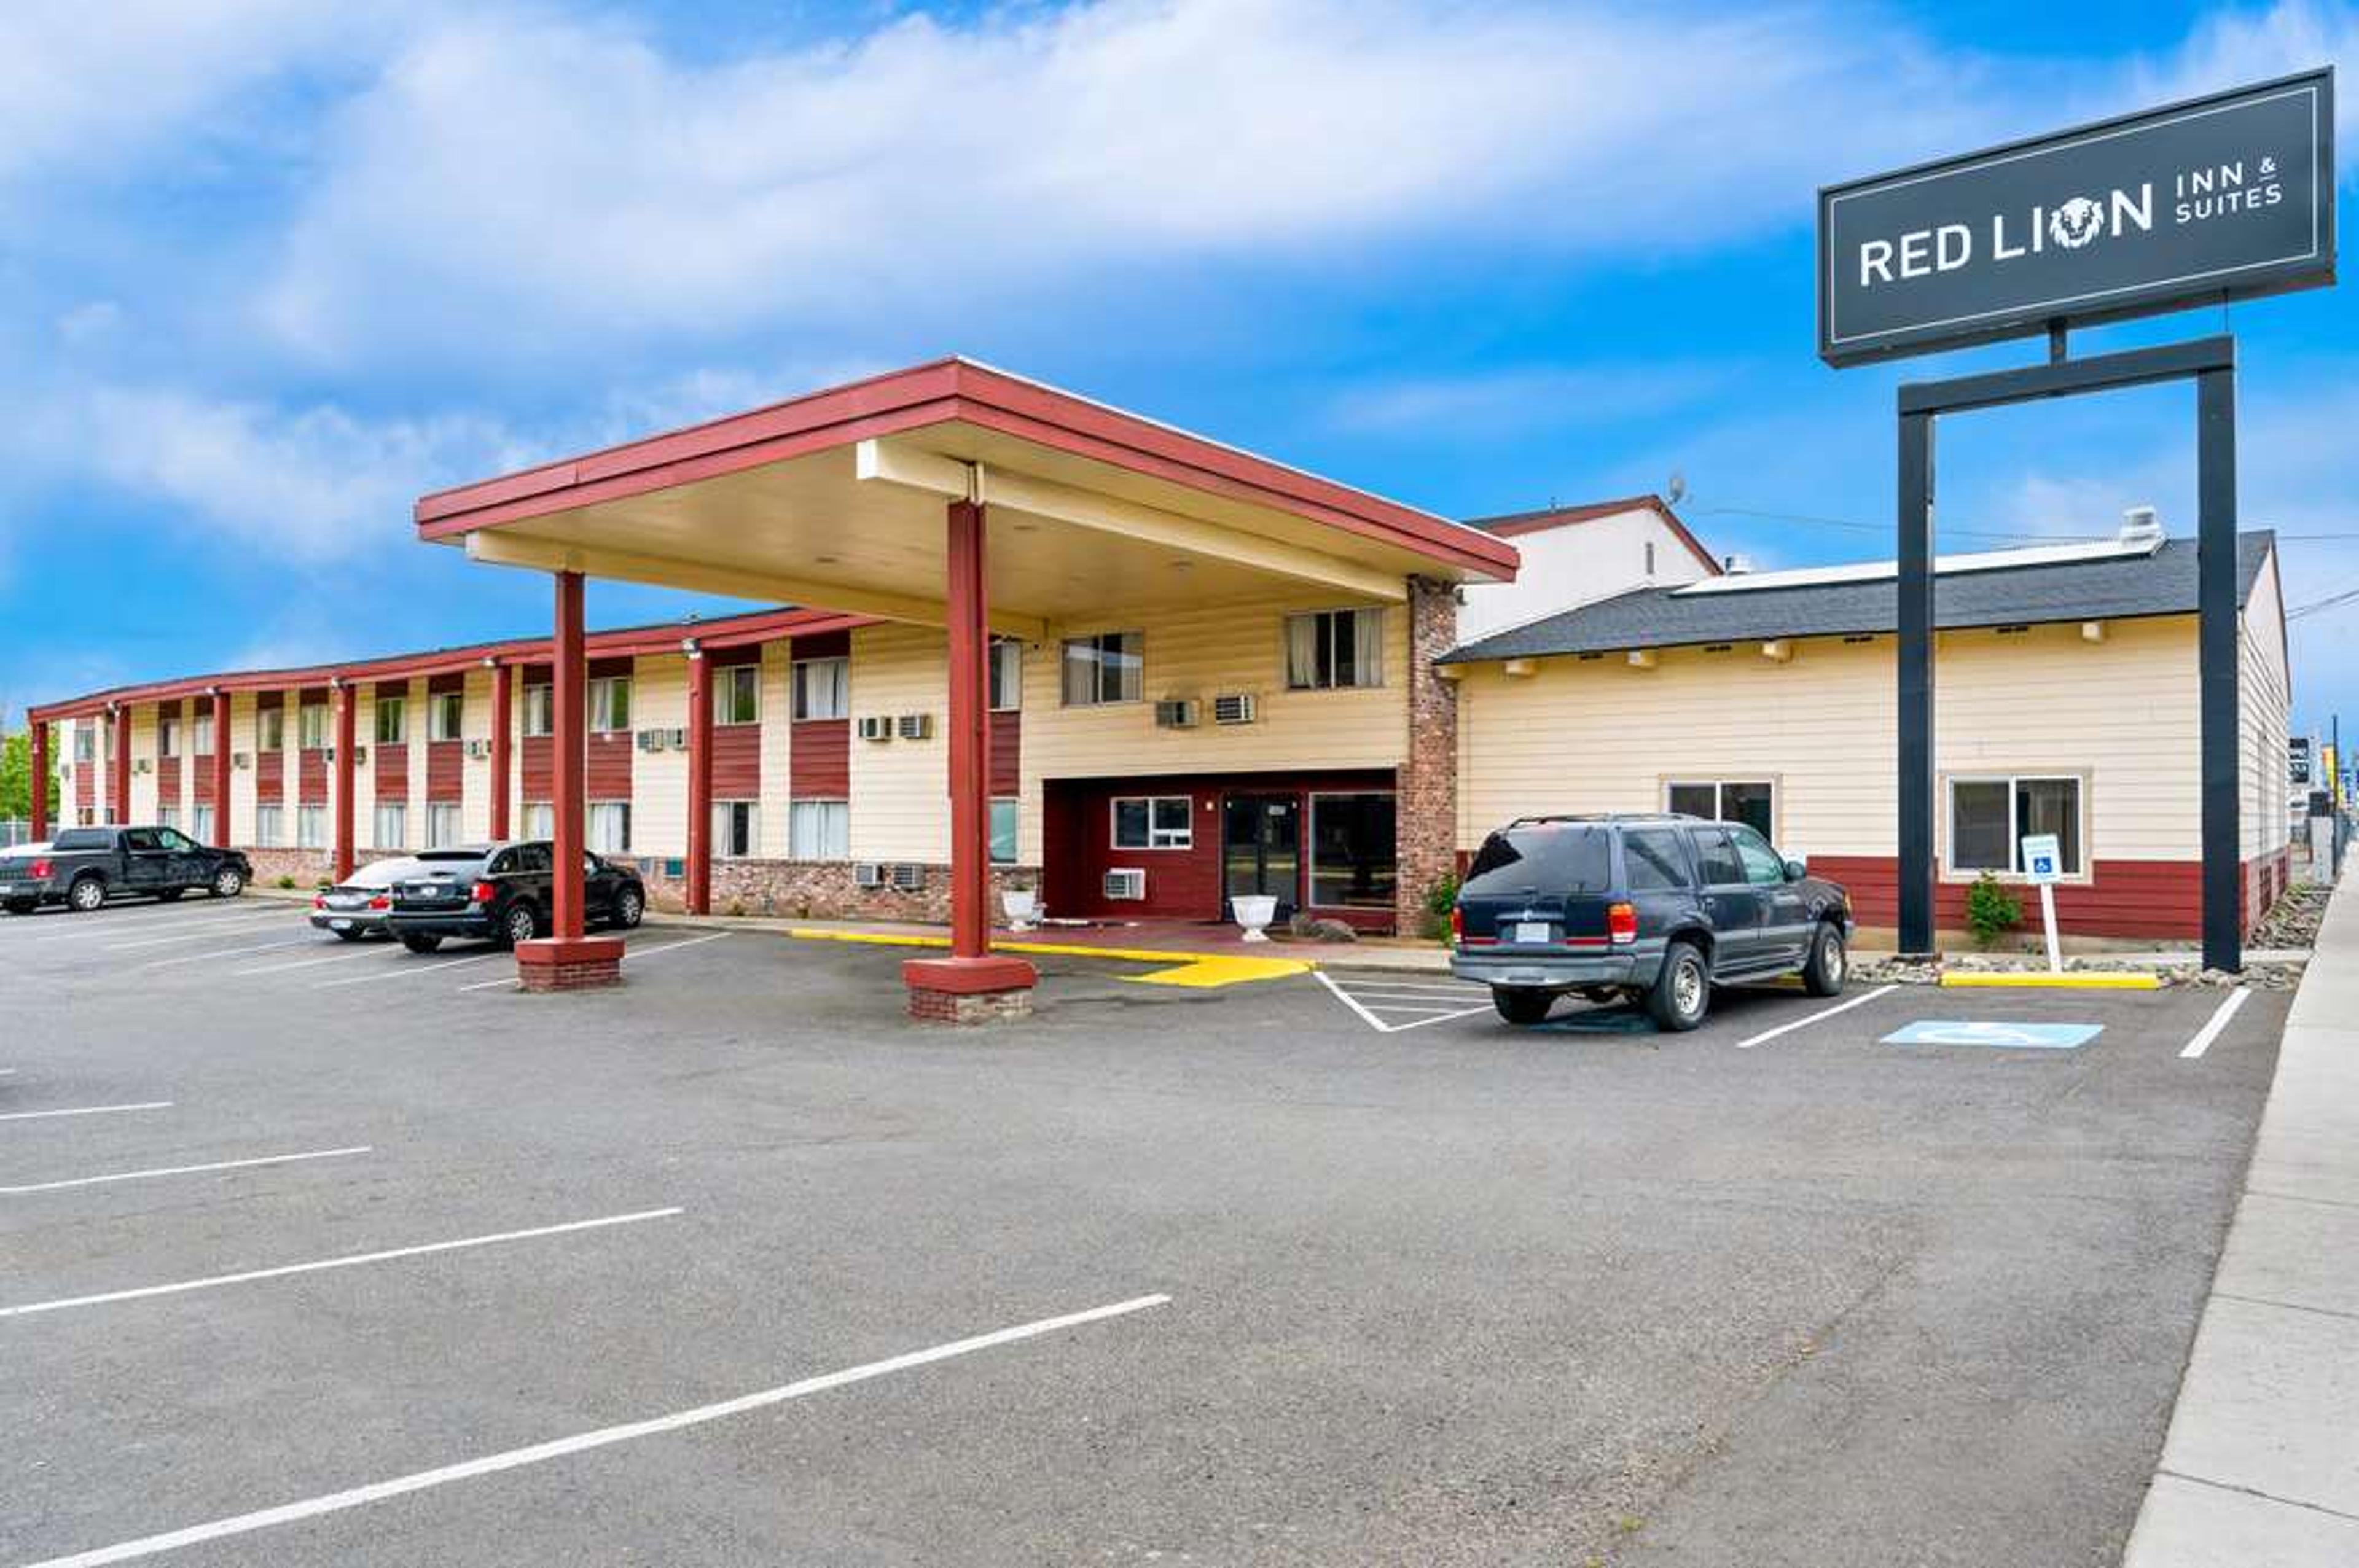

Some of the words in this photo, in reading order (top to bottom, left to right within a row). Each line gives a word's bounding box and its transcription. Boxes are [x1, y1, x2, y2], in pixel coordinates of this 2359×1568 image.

[2177, 162, 2244, 198] INN
[2259, 156, 2277, 174] &
[2175, 183, 2282, 223] SUITES
[1860, 225, 1971, 286] RED
